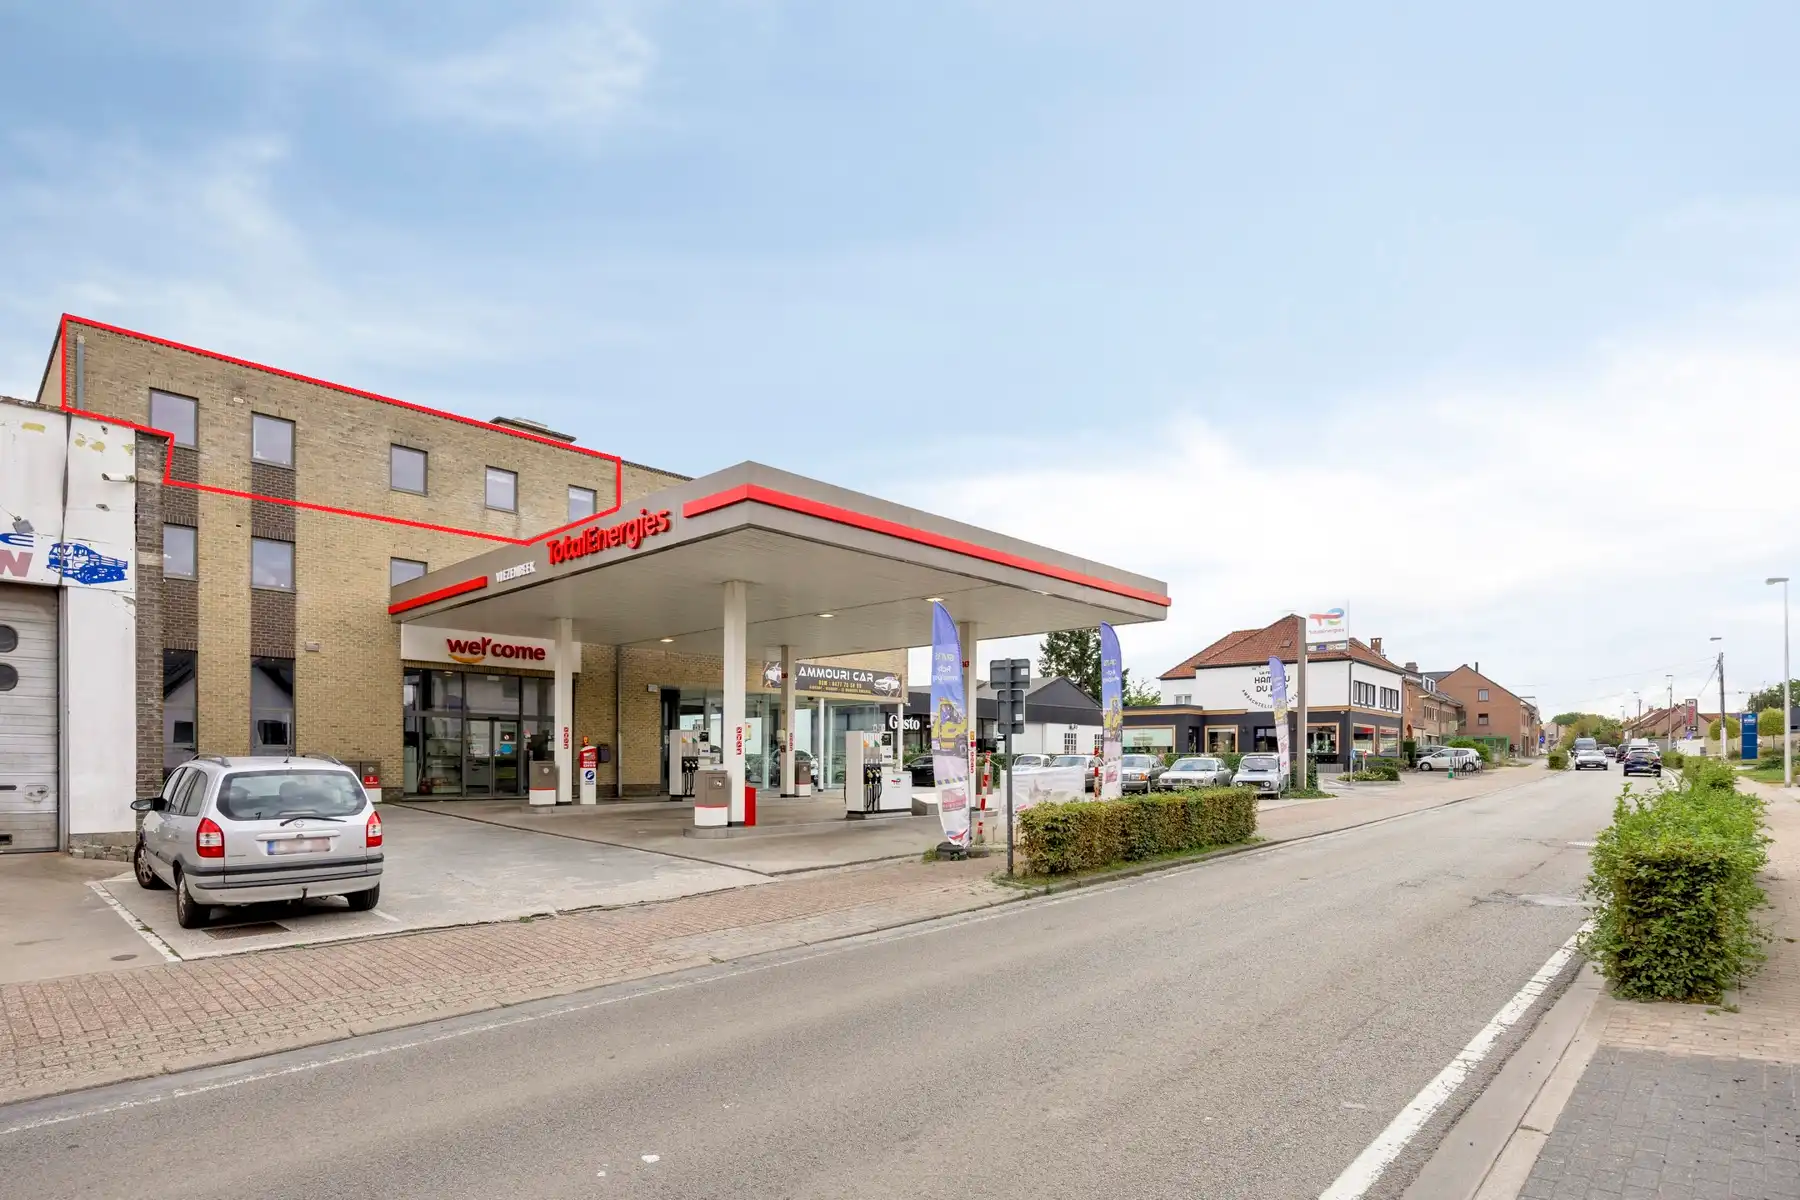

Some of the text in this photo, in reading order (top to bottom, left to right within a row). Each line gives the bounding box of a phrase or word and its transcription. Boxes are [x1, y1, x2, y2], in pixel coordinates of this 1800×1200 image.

[546, 508, 671, 566] TotalEnergies
[798, 666, 850, 681] AMMOURI
[853, 671, 874, 683] CAR
[889, 714, 920, 730] Gsto
